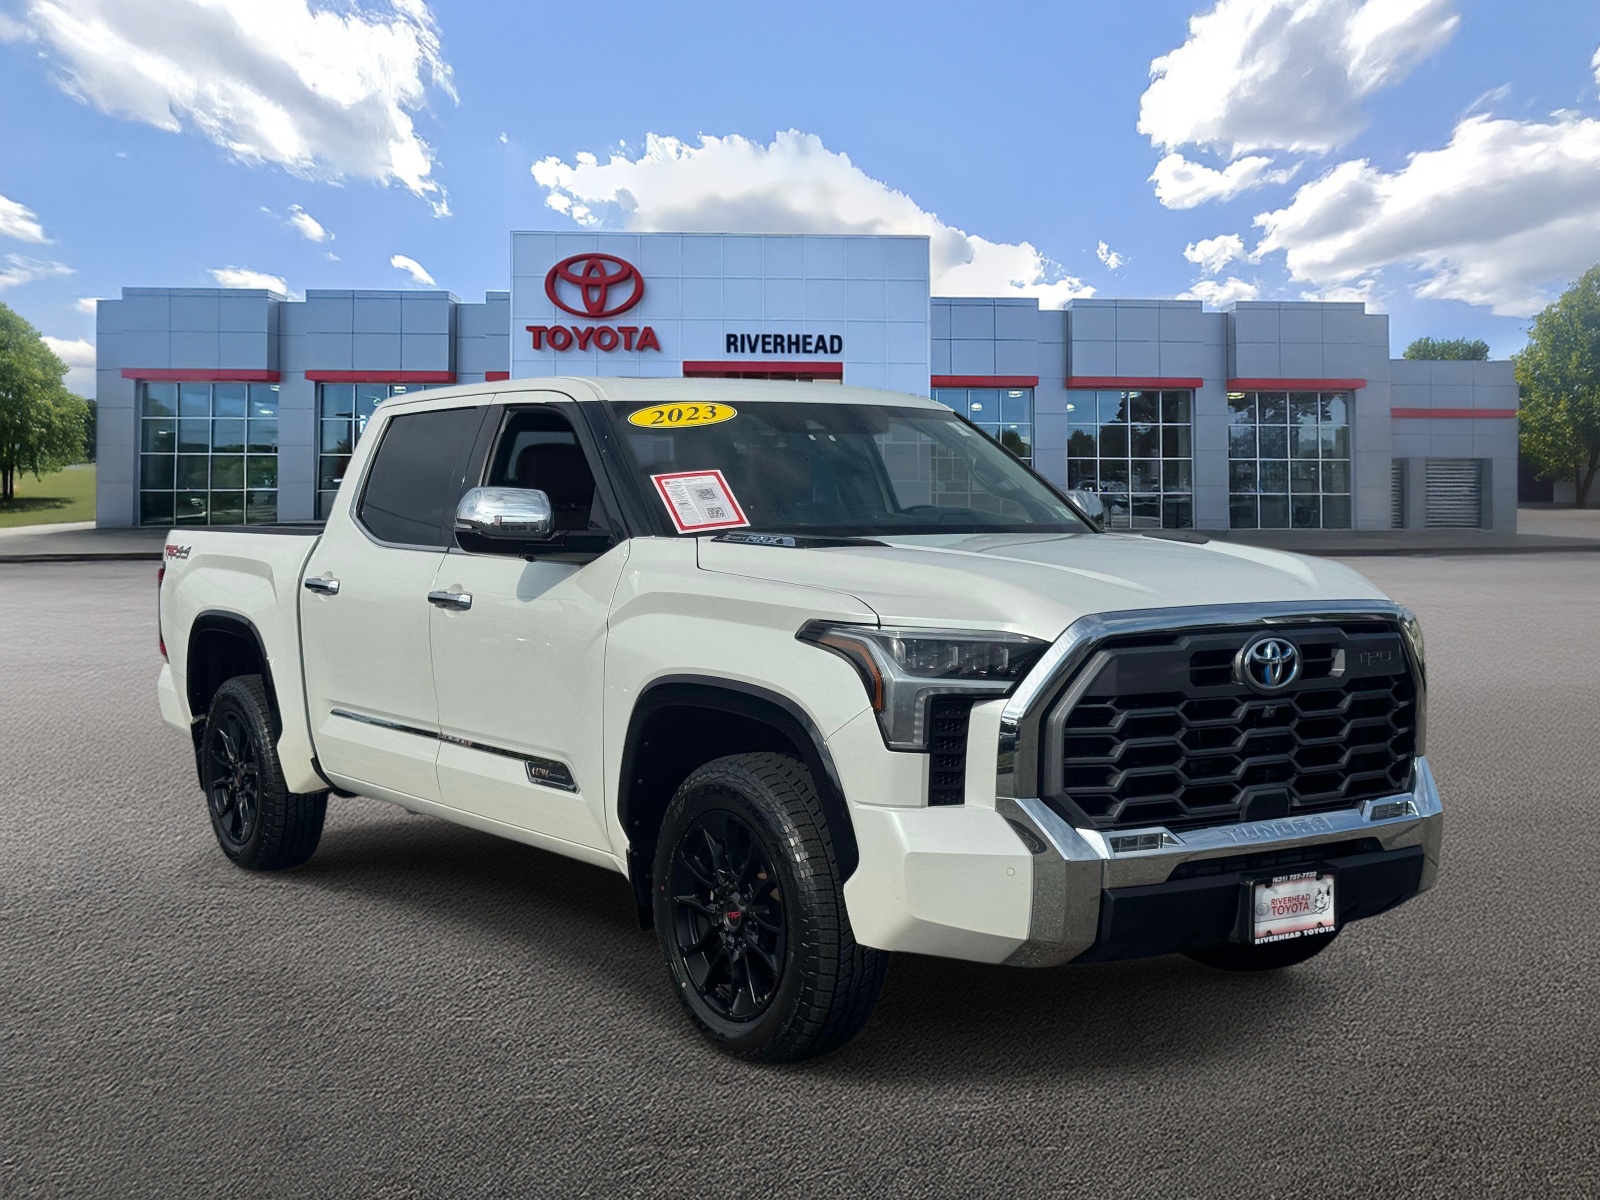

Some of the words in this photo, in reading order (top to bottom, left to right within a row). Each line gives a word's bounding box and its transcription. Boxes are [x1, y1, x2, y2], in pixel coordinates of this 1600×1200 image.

[526, 326, 661, 351] TOYOTA
[726, 334, 843, 353] RIVERHEAD
[650, 405, 717, 425] 2023
[1219, 816, 1333, 842] TUNDRA
[1270, 893, 1311, 906] RIVERHEAD
[1270, 902, 1310, 916] TOYOTA
[1254, 931, 1301, 945] RIVERHEAD
[1303, 925, 1335, 936] TOYOTA
